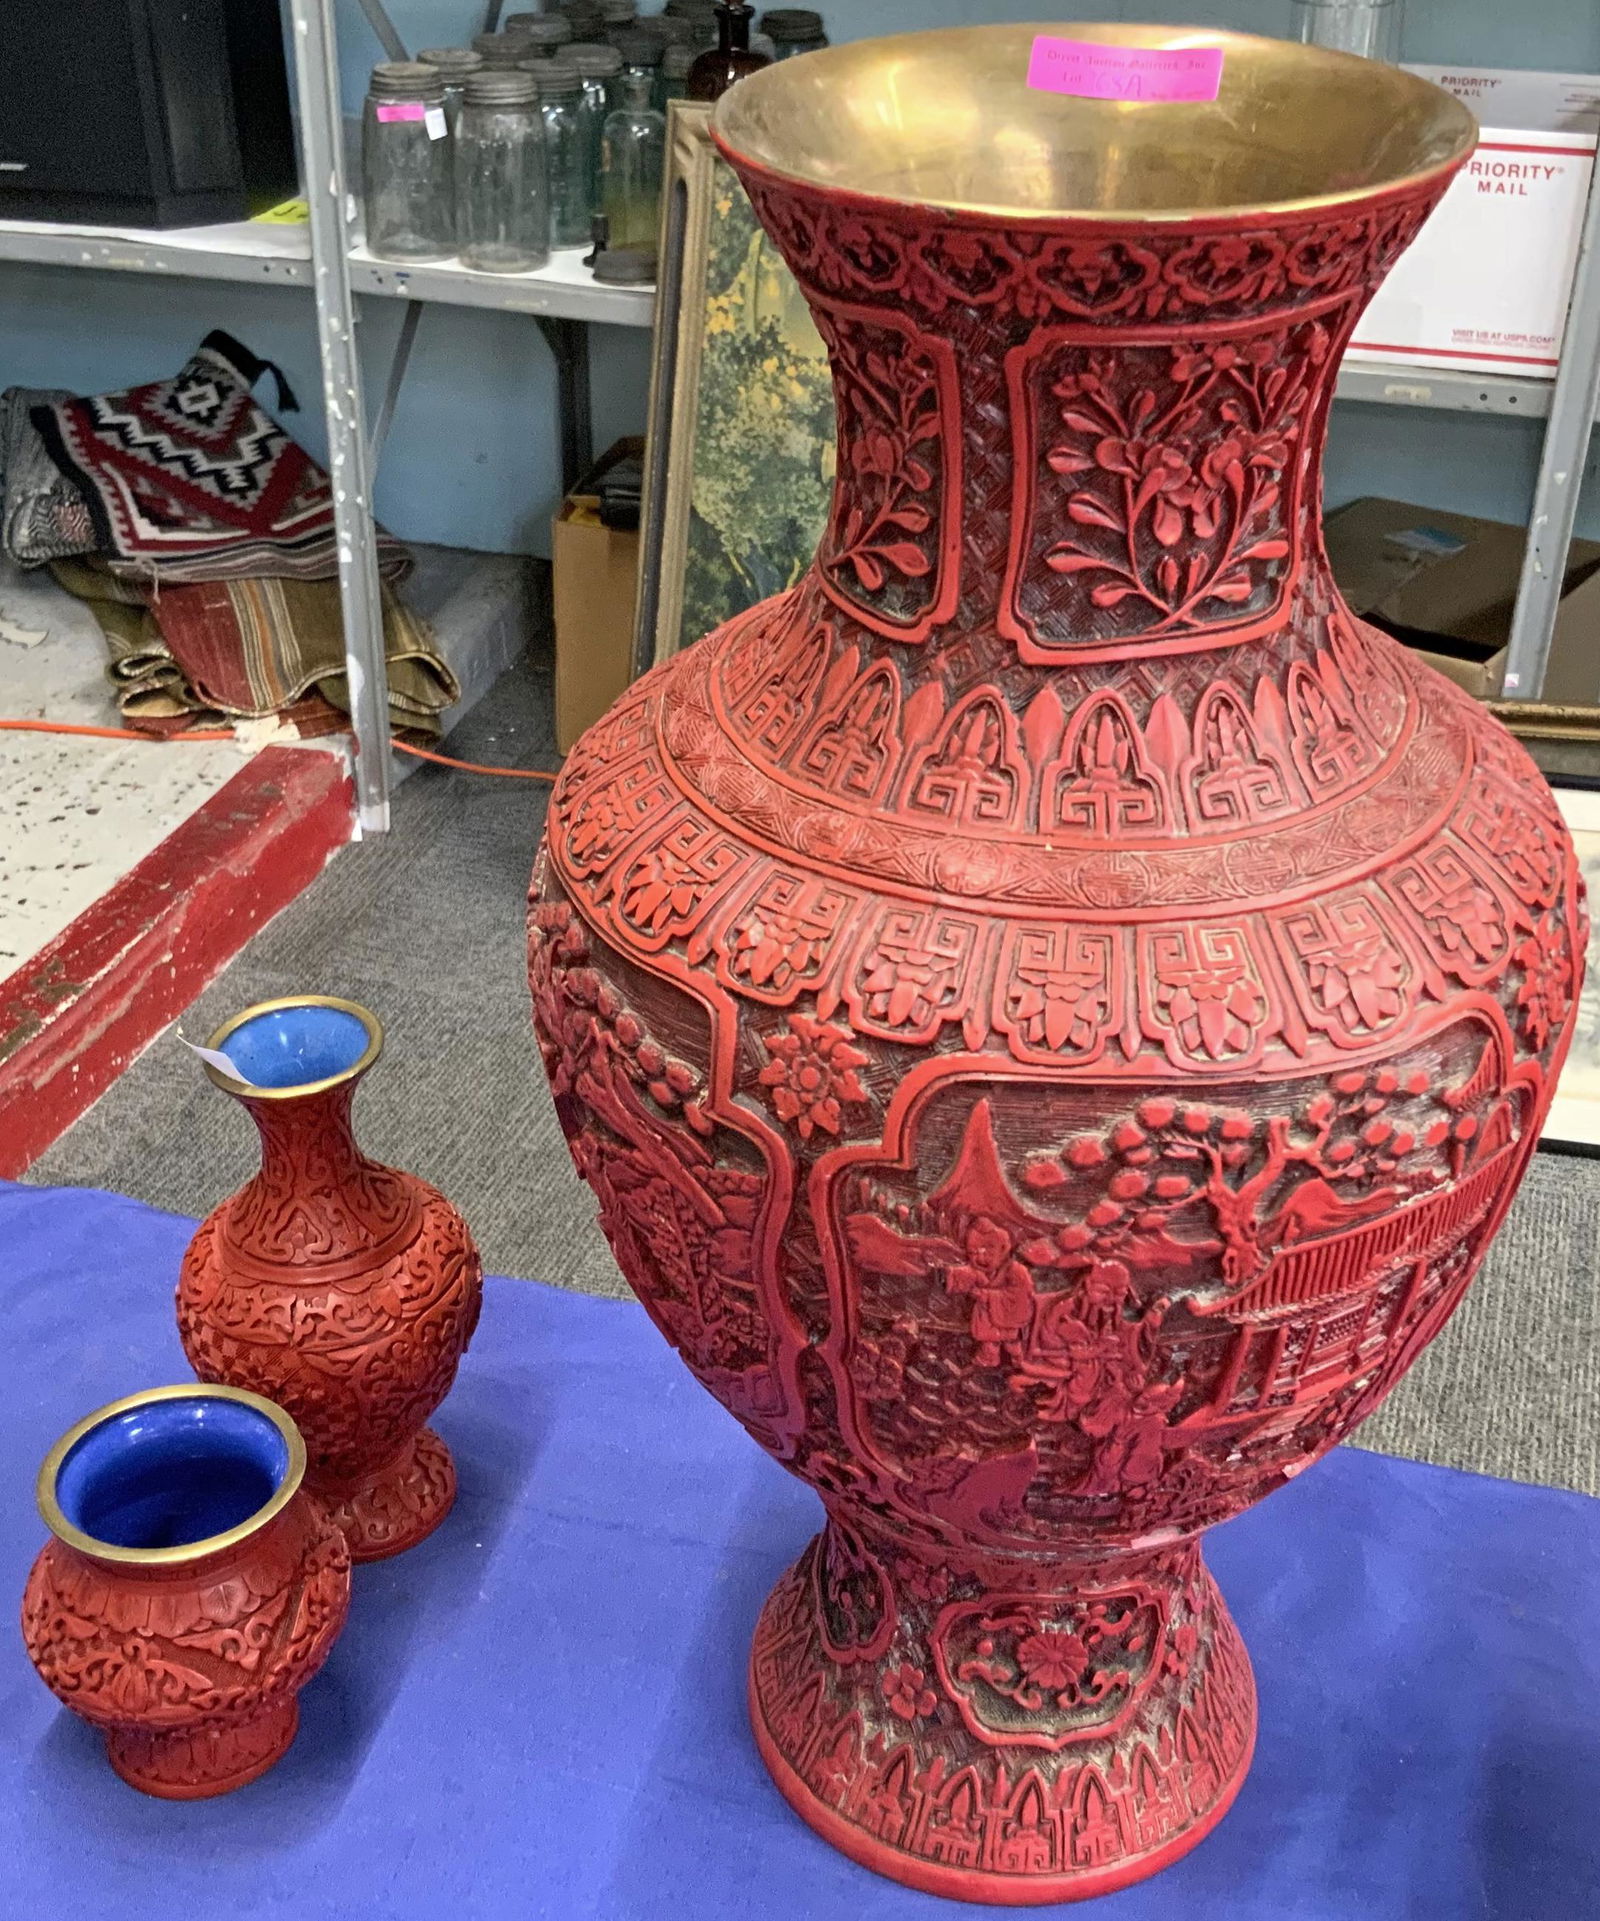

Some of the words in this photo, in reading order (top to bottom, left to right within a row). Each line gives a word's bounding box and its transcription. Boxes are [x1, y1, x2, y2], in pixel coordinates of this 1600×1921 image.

[1453, 88, 1481, 97] MAIL
[1464, 161, 1555, 179] RIORITY
[1477, 181, 1528, 196] MAIL
